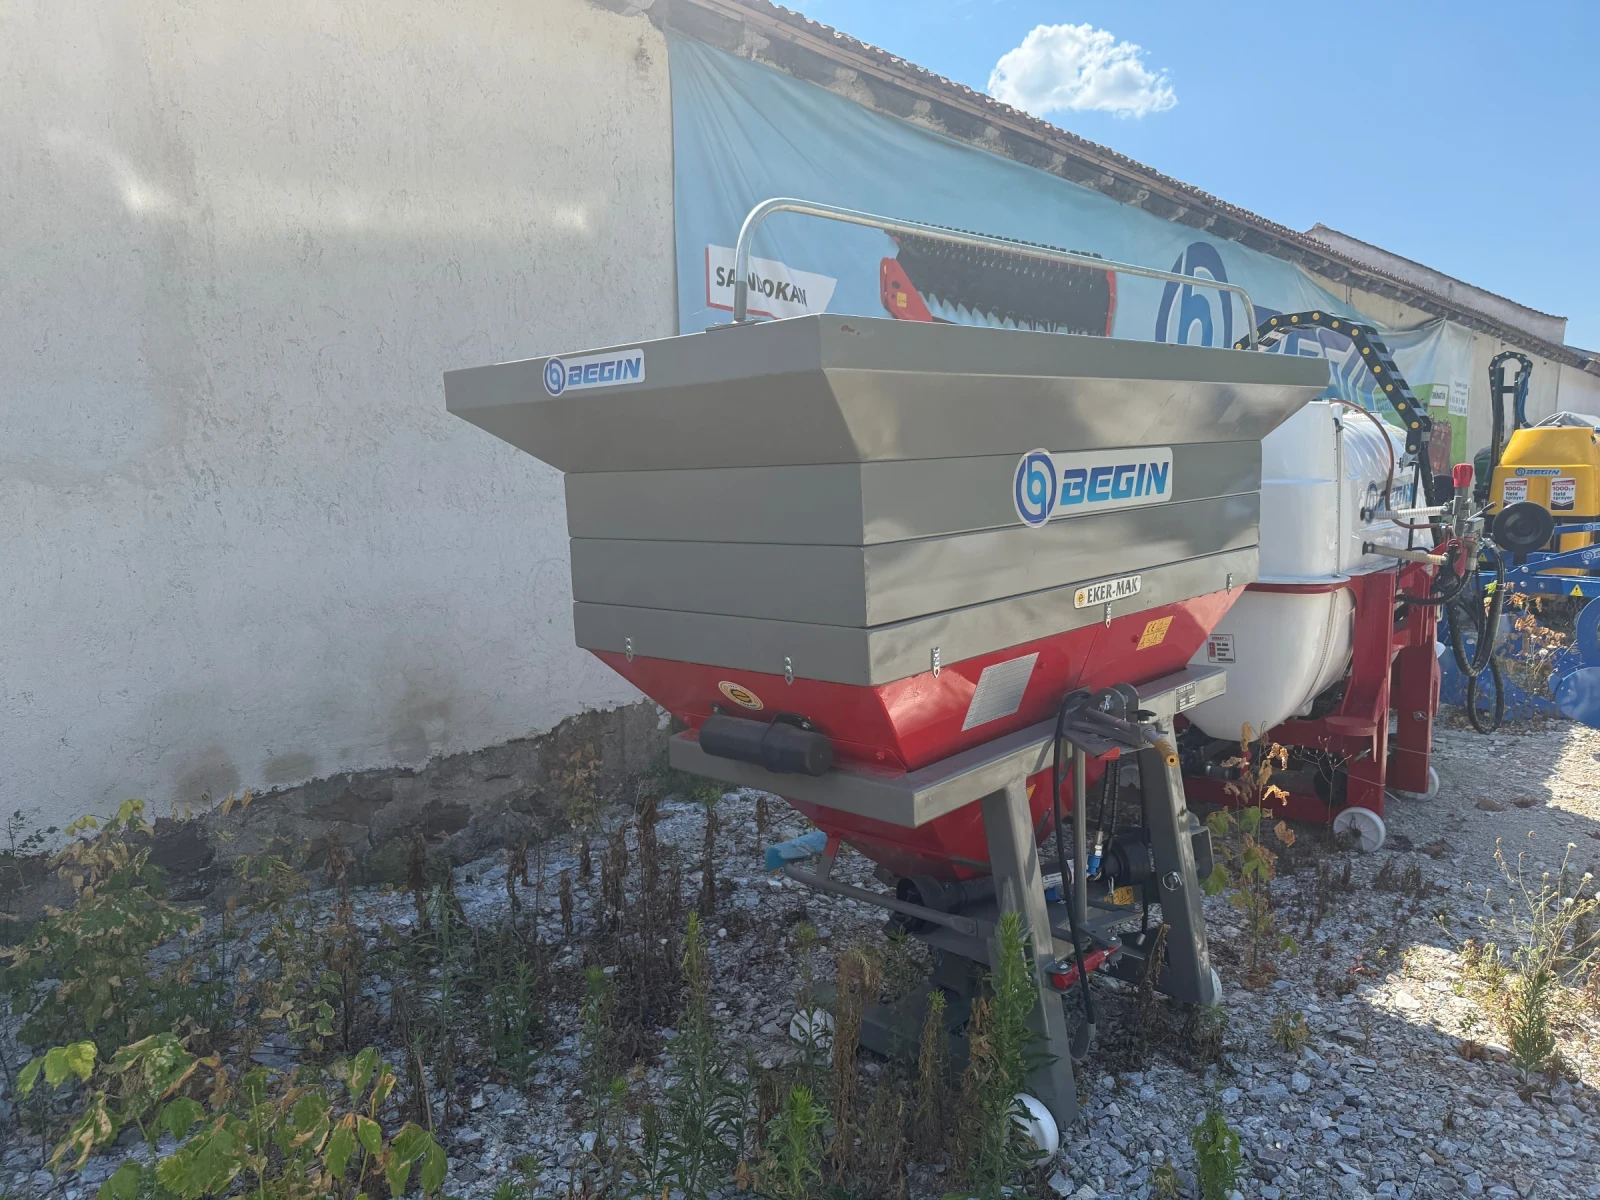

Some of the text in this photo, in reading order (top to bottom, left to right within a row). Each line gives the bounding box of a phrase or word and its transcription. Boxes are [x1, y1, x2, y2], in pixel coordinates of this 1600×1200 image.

[567, 357, 641, 386] BEGIN
[1059, 461, 1170, 506] BEGIN
[1087, 577, 1138, 603] EKER-MAK
